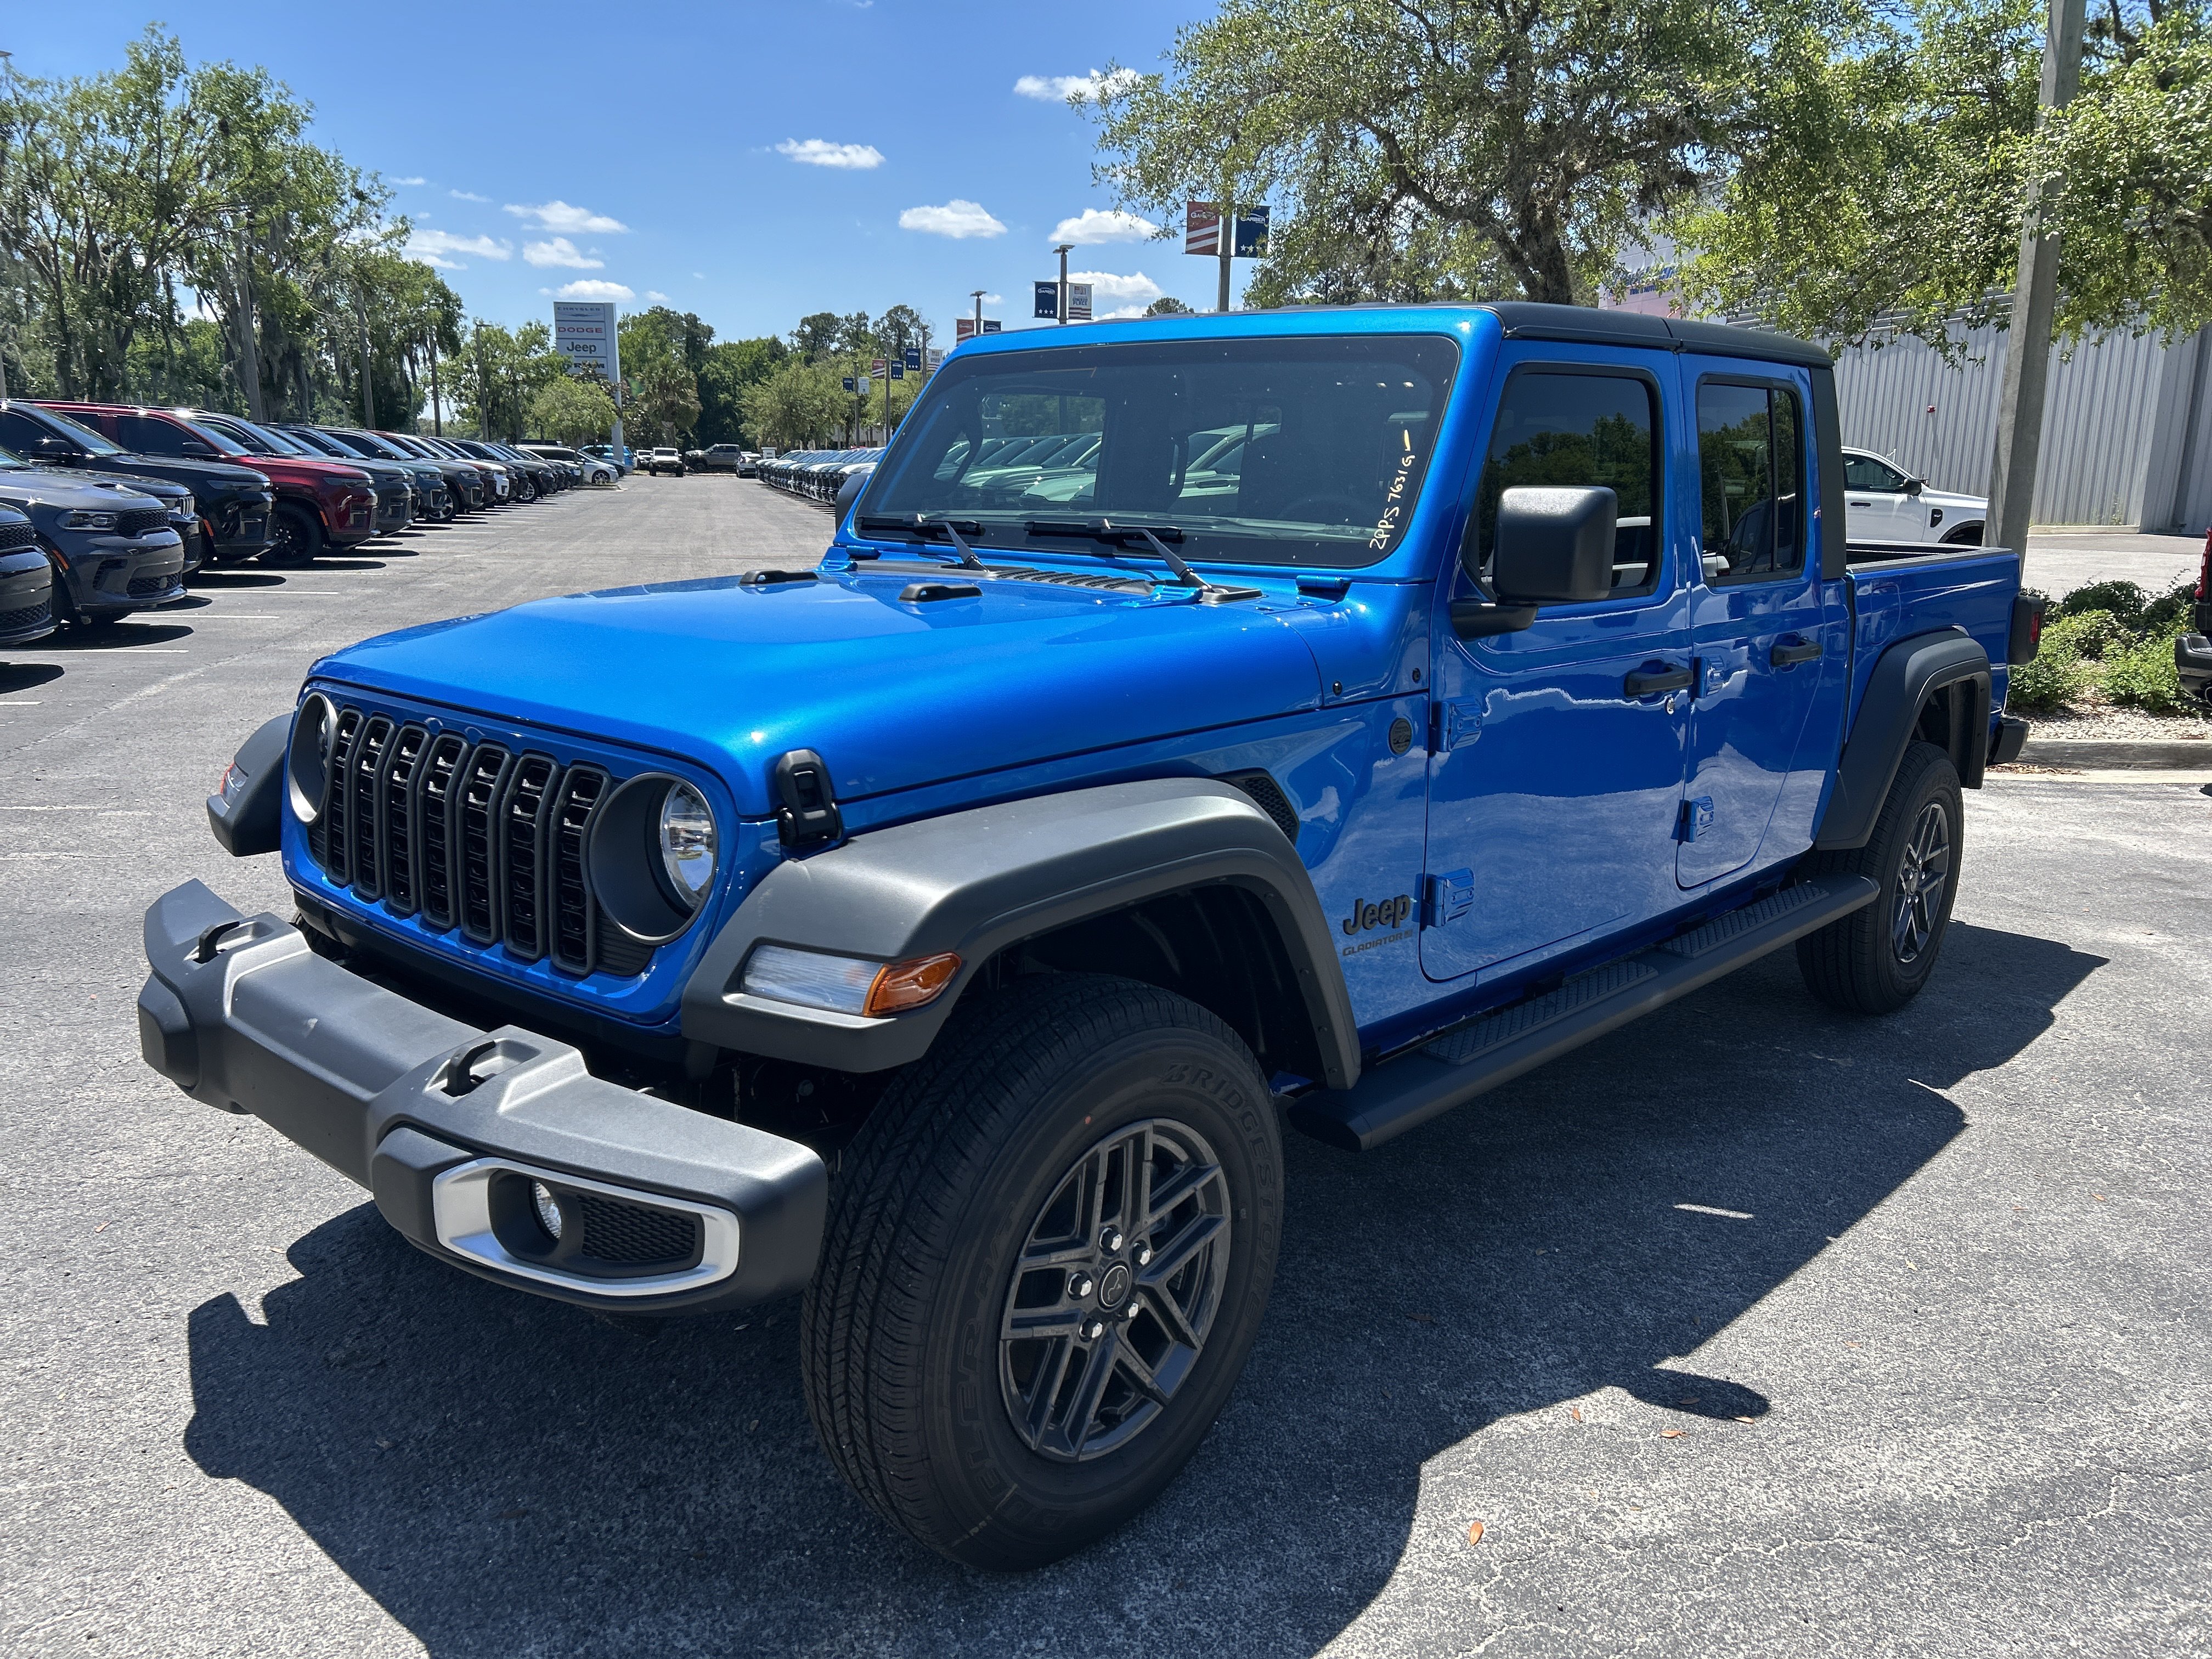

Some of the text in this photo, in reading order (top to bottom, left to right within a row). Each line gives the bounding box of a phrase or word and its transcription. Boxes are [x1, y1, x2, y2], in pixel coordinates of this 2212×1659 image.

[566, 341, 596, 354] Jeep
[1342, 894, 1410, 935] Jeep
[1342, 932, 1403, 956] GLADIATOR
[1160, 1062, 1278, 1320] BRIDGESTONE
